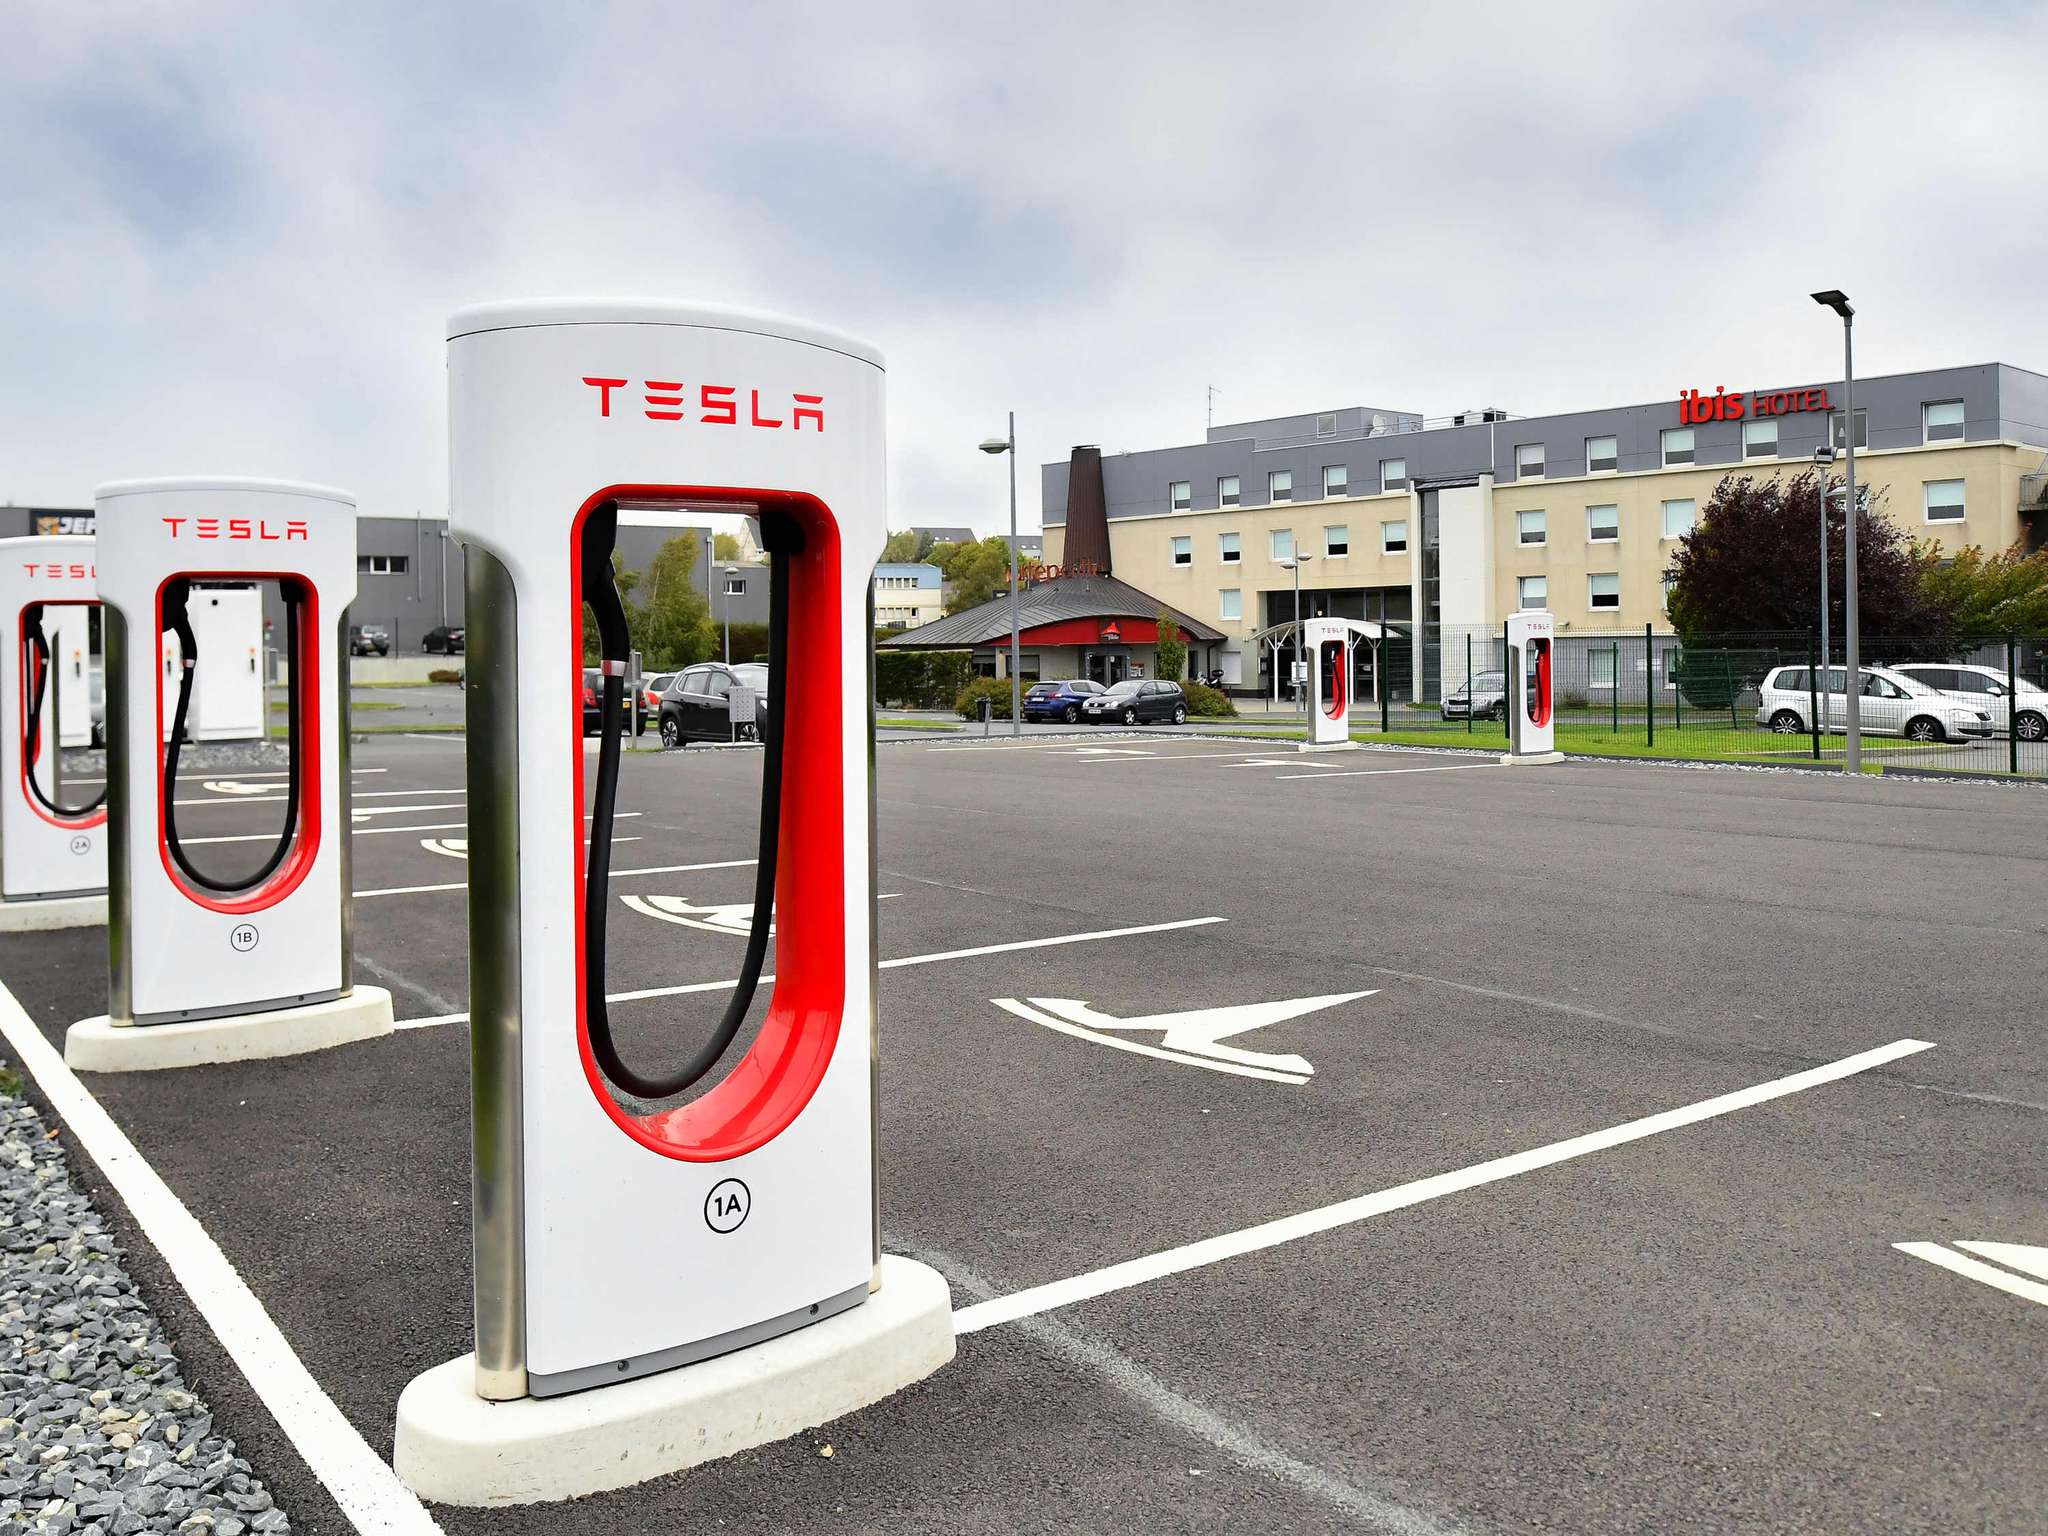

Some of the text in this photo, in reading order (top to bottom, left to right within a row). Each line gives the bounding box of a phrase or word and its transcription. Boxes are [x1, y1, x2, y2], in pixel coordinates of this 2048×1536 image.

[581, 376, 824, 433] TESLA
[1679, 385, 1836, 425] ibis HOTEL
[161, 517, 308, 541] TESLA
[236, 931, 252, 943] 1B
[714, 1193, 742, 1217] 1A
